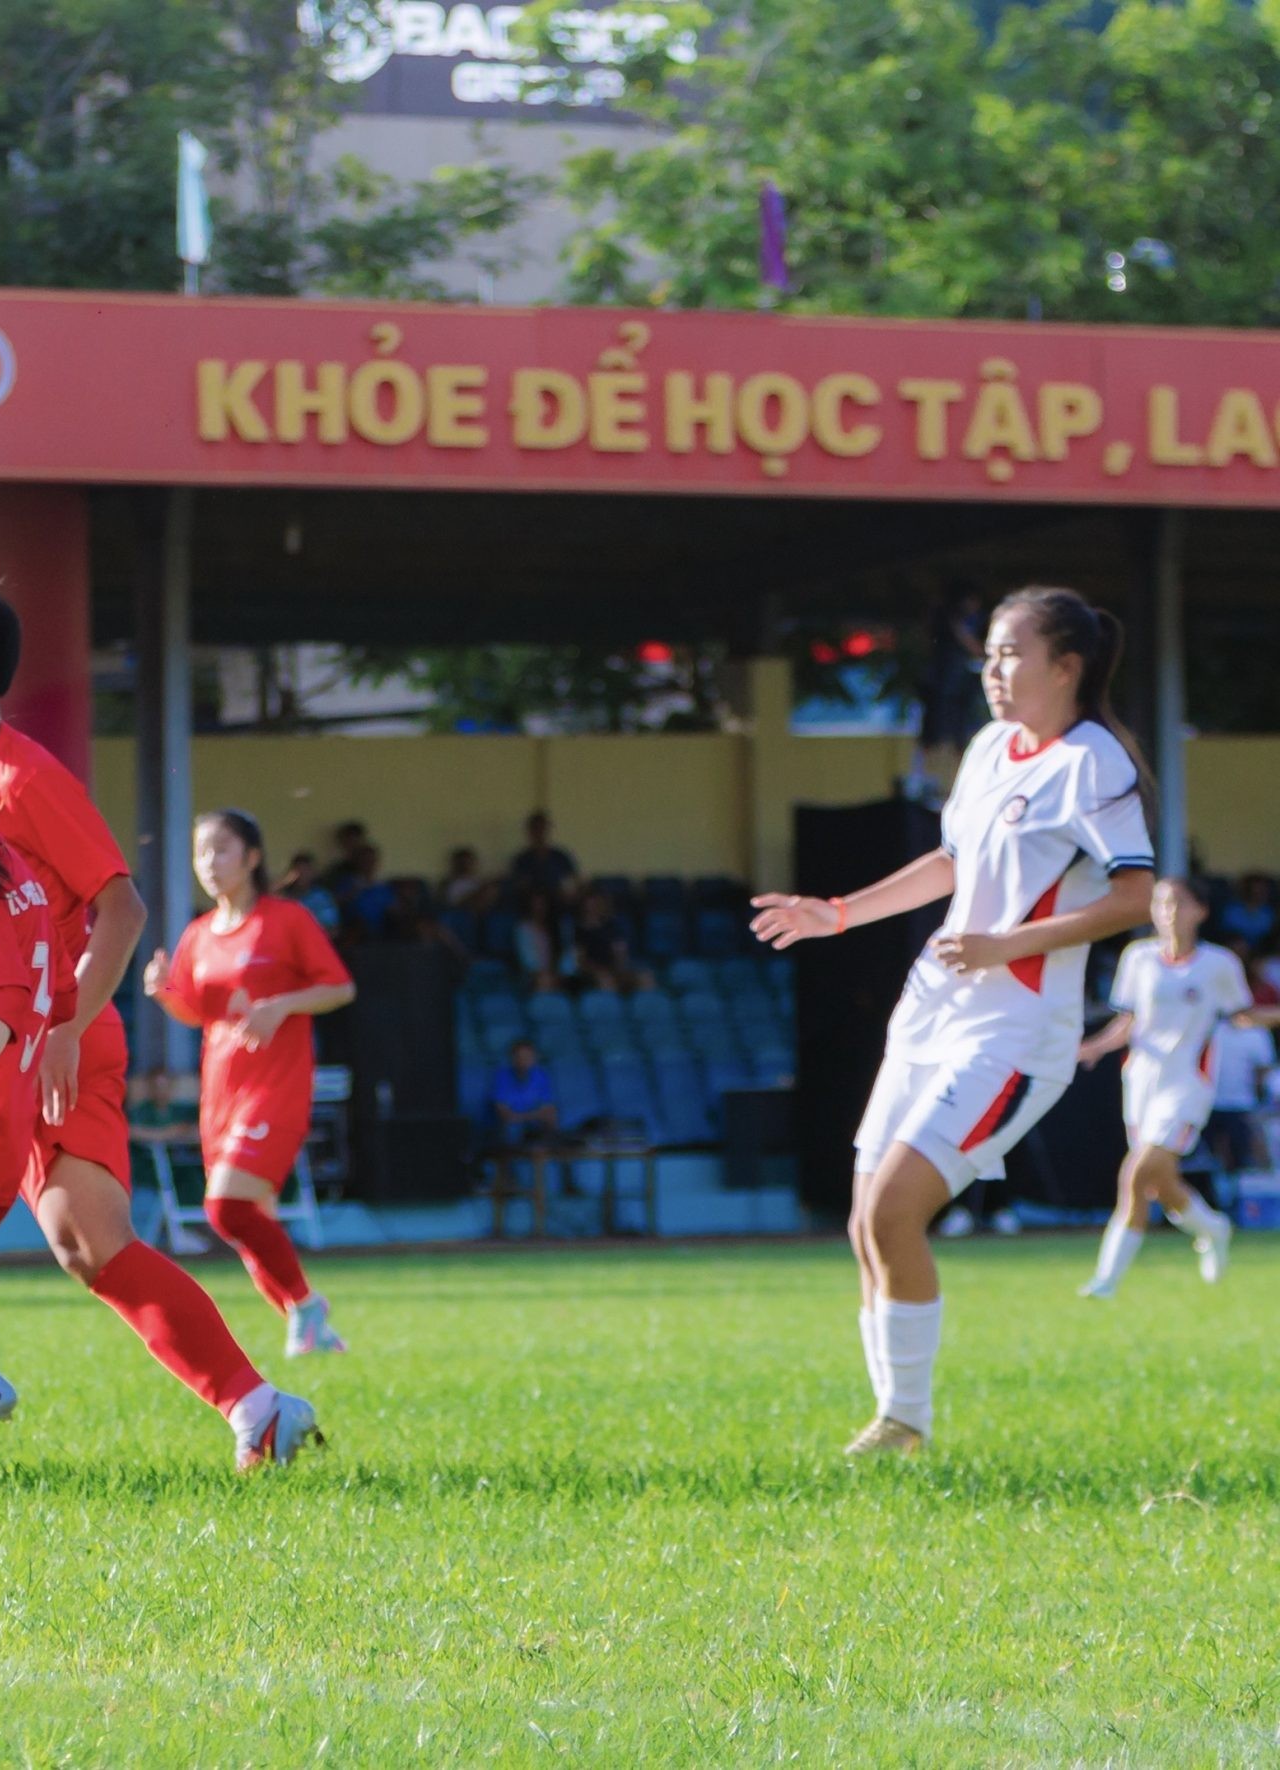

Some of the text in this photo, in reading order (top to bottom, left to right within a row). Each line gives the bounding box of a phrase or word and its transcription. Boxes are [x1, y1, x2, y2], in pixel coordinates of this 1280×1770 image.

[197, 321, 489, 449] KHỎE
[512, 320, 649, 454] ĐỂ
[665, 371, 882, 477] HỌC
[1148, 387, 1280, 468] LA
